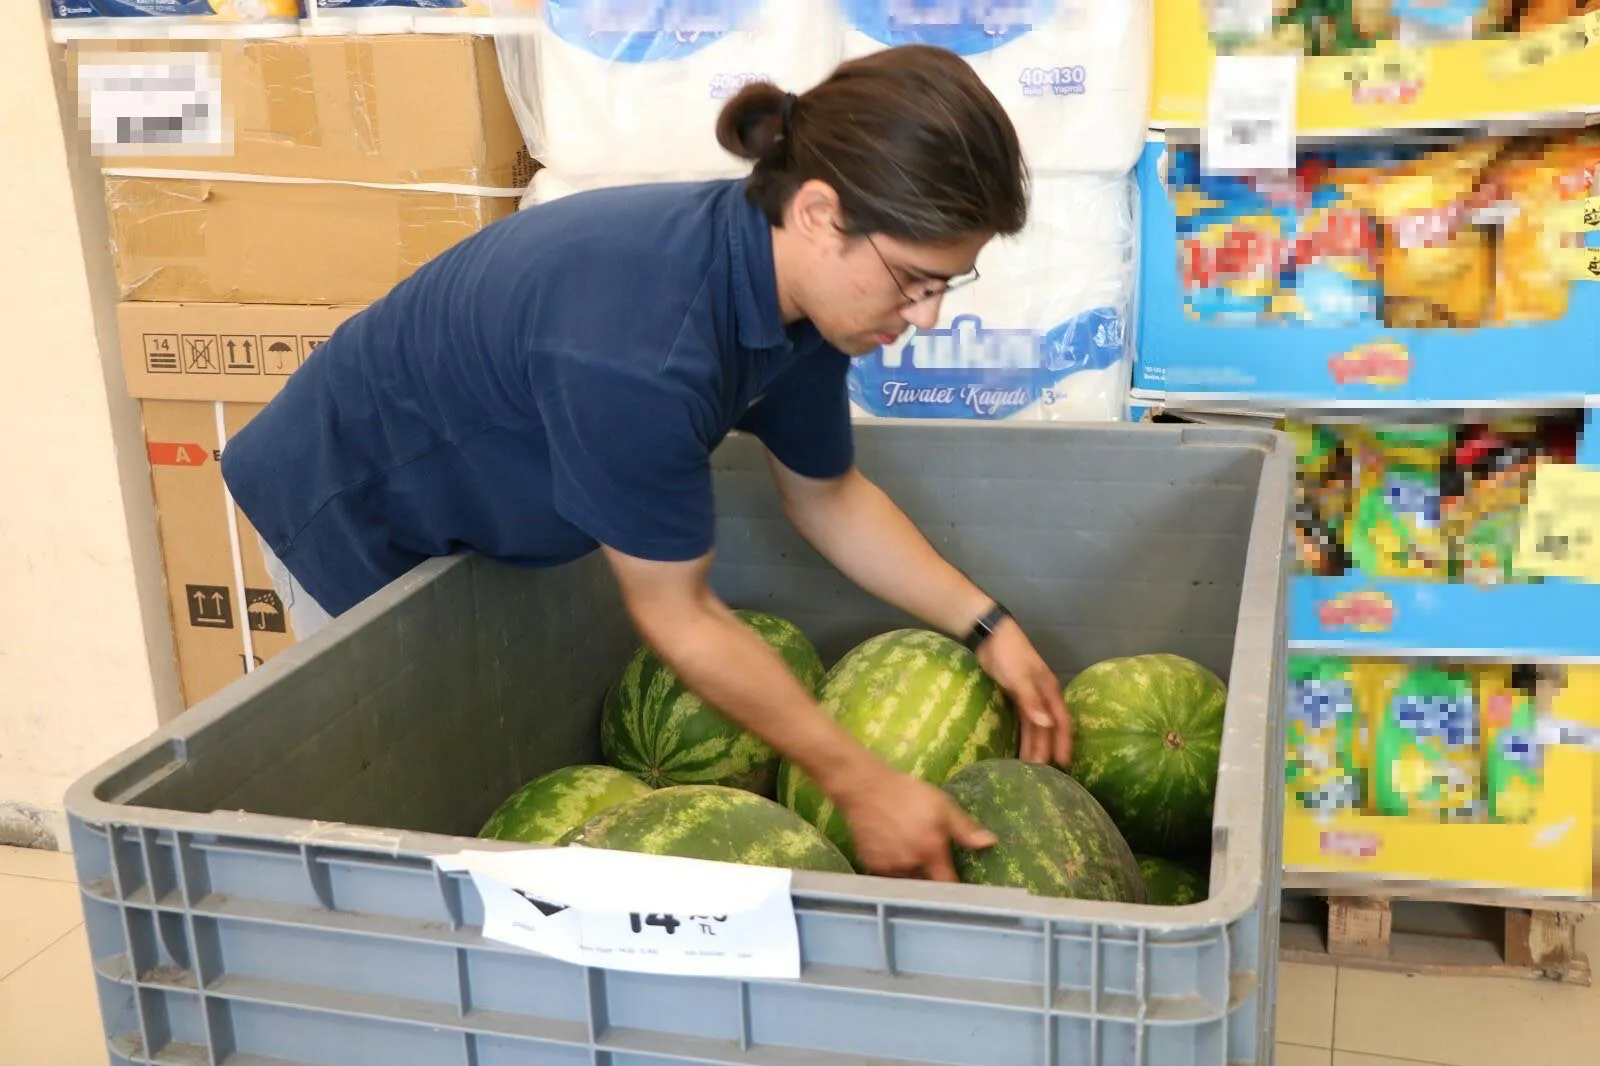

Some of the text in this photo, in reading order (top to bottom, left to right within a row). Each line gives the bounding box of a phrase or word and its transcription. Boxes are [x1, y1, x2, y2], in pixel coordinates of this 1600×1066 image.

[1019, 66, 1084, 86] 40x130
[153, 338, 169, 351] 14
[882, 380, 1027, 415] Tuvalet Kağıdı
[176, 446, 191, 463] A
